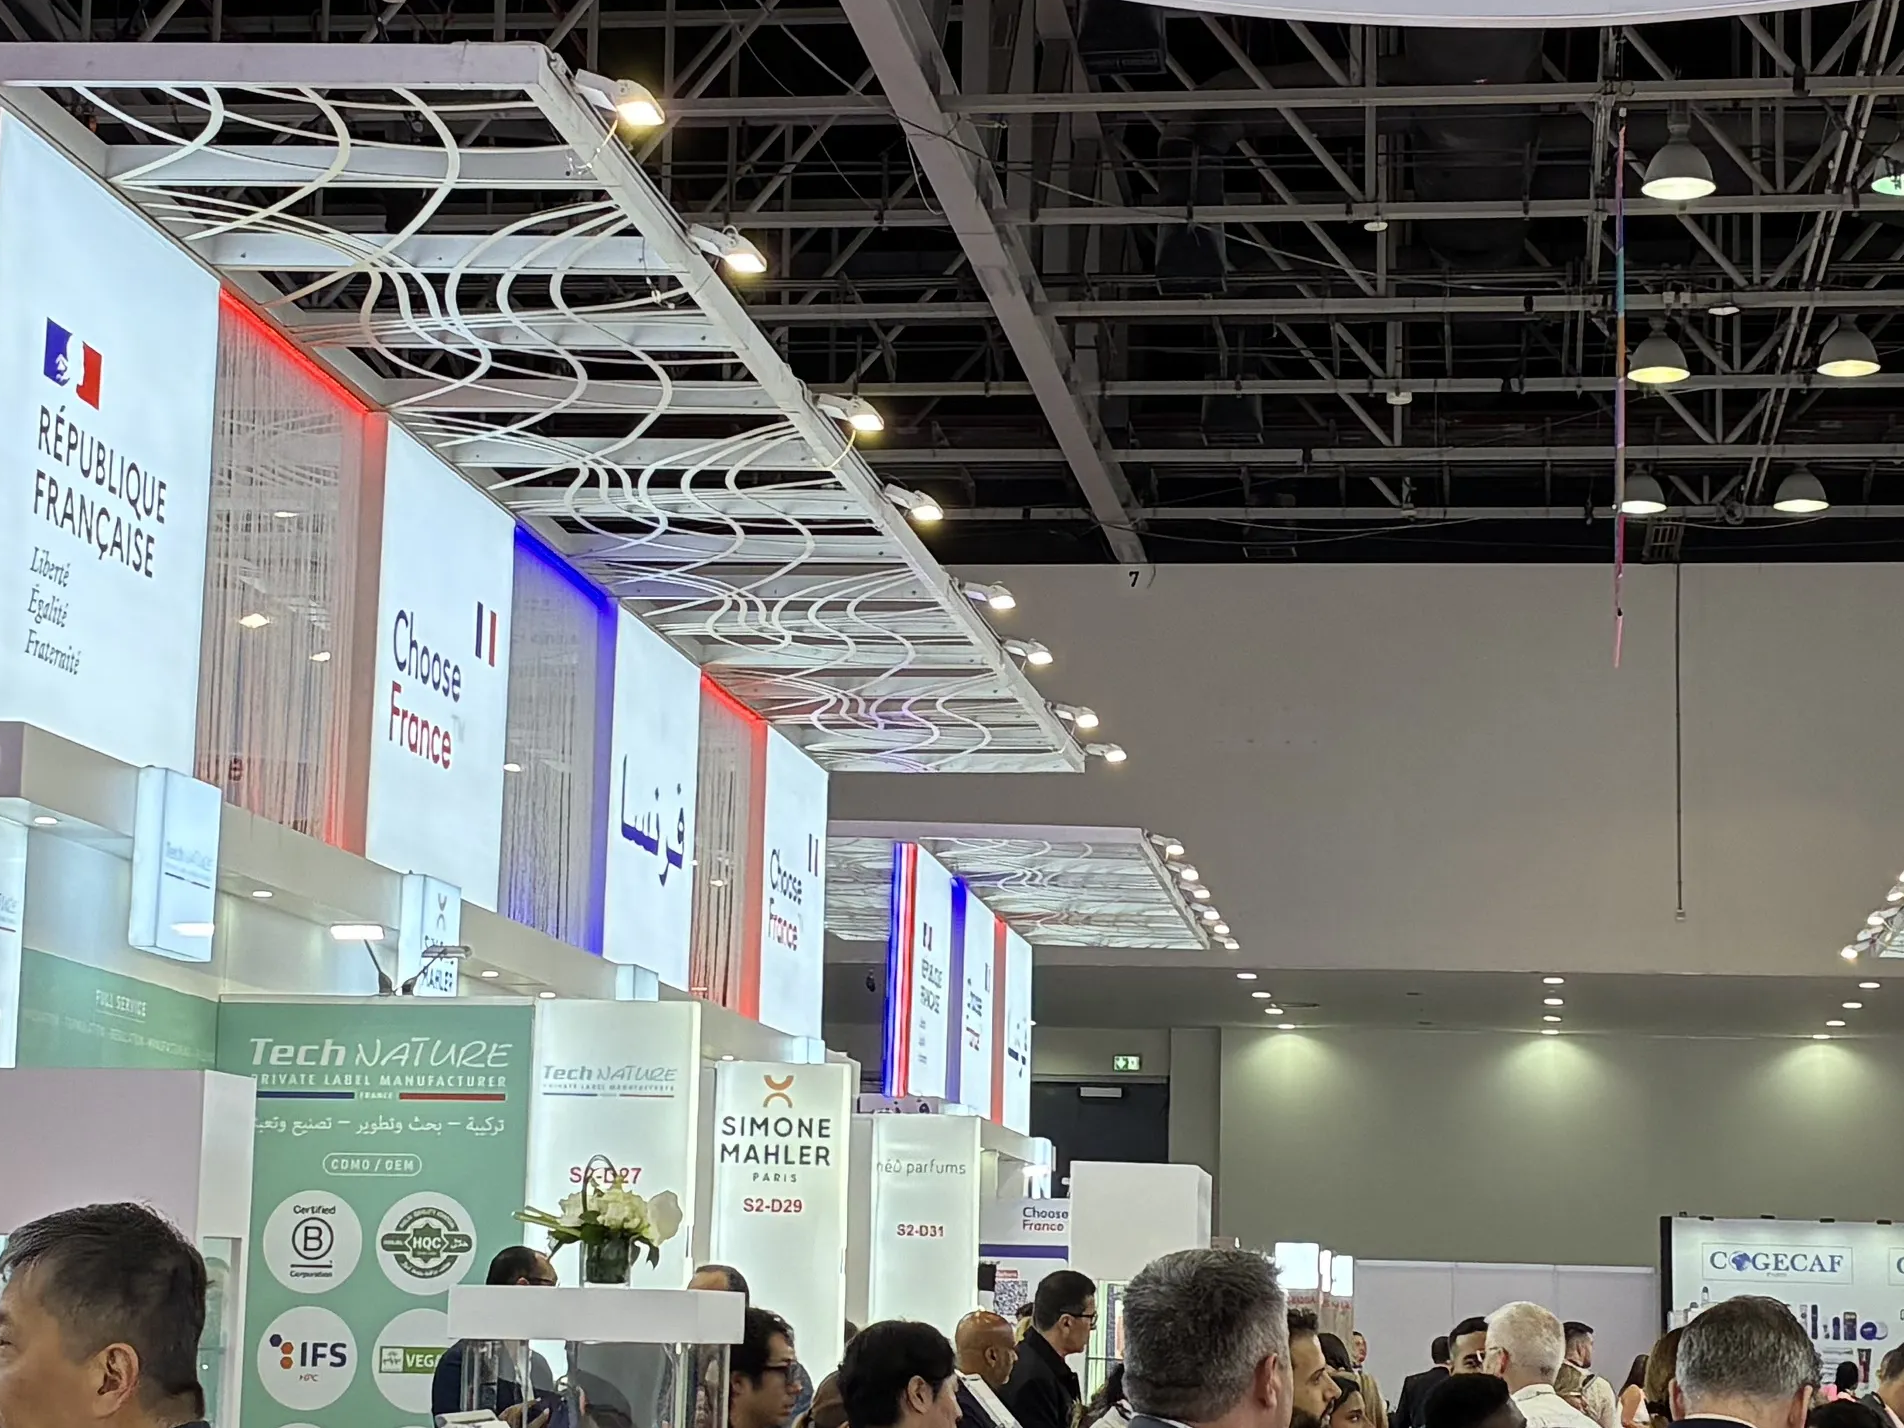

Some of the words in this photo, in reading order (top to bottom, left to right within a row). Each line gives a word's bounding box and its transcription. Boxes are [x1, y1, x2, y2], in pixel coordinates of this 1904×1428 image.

[38, 406, 167, 525] RÉPUBLIQUE
[33, 469, 156, 580] FRANÇAISE
[29, 545, 71, 589] Liberté
[27, 587, 69, 629] Égalité
[24, 629, 81, 676] Fraternité
[392, 609, 462, 704] Choose
[388, 681, 453, 770] France
[620, 753, 687, 887] فرنسا
[768, 848, 803, 907] Choose
[249, 1038, 346, 1066] Tech
[355, 1036, 513, 1069] NATURE
[324, 1074, 371, 1086] LABEL
[380, 1074, 507, 1088] MANUFACTURER
[542, 1065, 591, 1082] Tech
[596, 1065, 677, 1082] NATURE
[408, 1117, 442, 1136] بحث
[721, 1116, 831, 1138] SIMONE
[330, 1158, 369, 1171] CDMO
[385, 1159, 414, 1171] OEM
[720, 1144, 830, 1166] MAHLER
[752, 1172, 798, 1184] PARIS
[907, 1160, 966, 1177] parfums
[293, 1205, 336, 1215] Certified
[743, 1198, 803, 1213] S2-D29
[1022, 1206, 1068, 1219] Choose
[896, 1223, 945, 1237] S2-D31
[1023, 1220, 1064, 1231] France
[412, 1236, 441, 1249] HQC
[300, 1342, 347, 1367] IFS
[405, 1353, 440, 1368] VEGA
